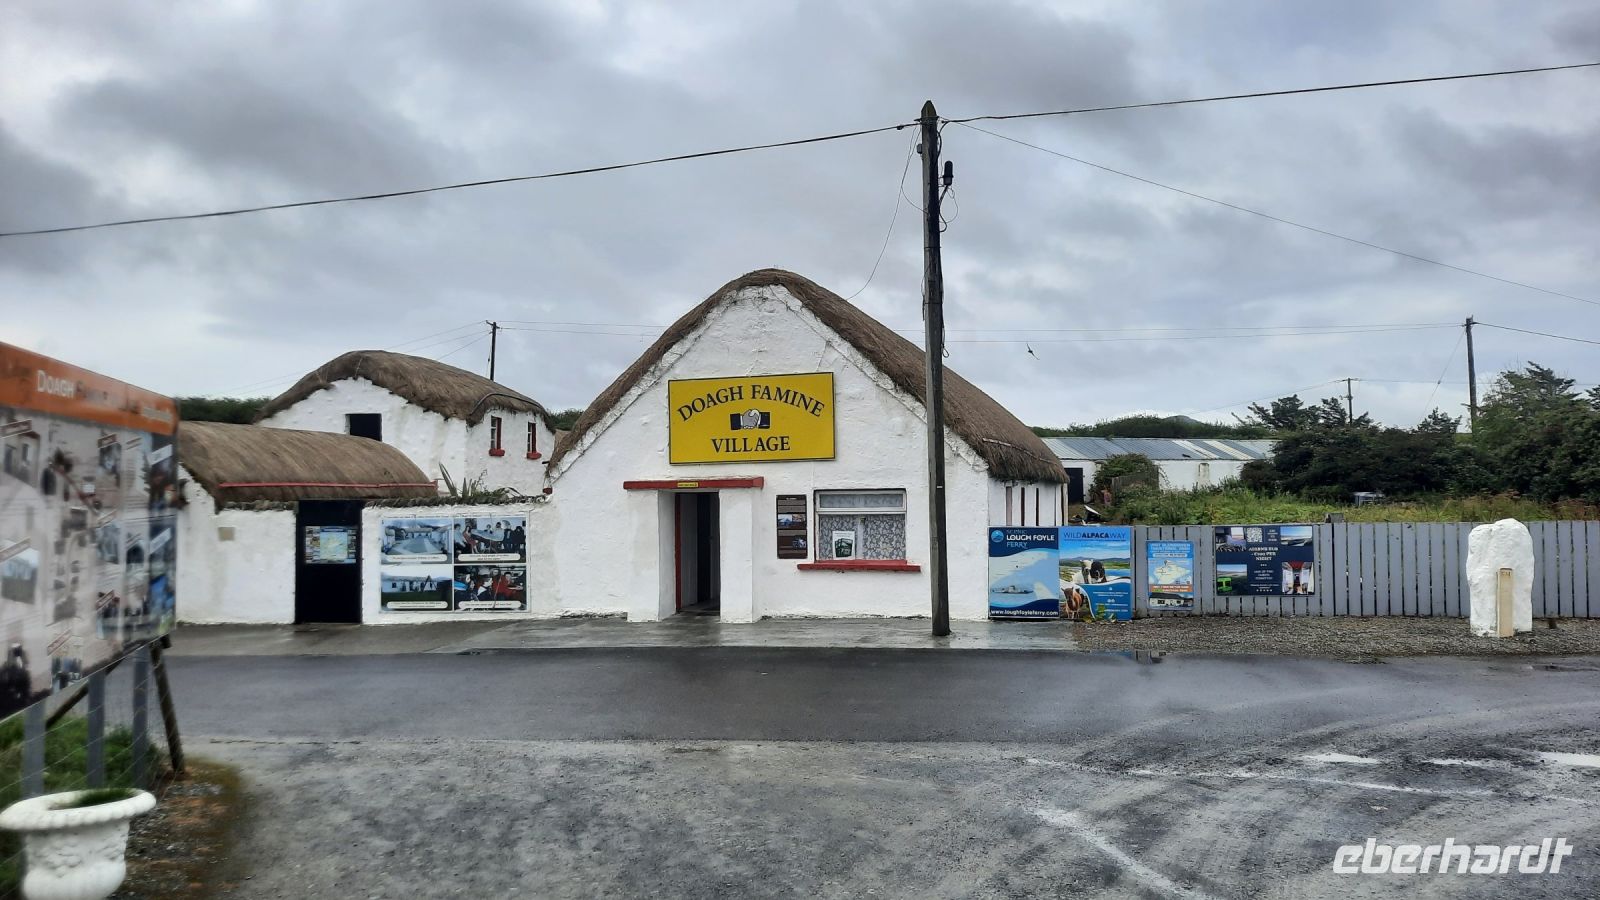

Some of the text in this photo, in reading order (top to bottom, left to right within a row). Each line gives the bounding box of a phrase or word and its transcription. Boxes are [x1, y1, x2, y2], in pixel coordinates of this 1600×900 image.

[677, 385, 825, 421] DOAGH FAMINE
[711, 436, 791, 453] VILLAGE
